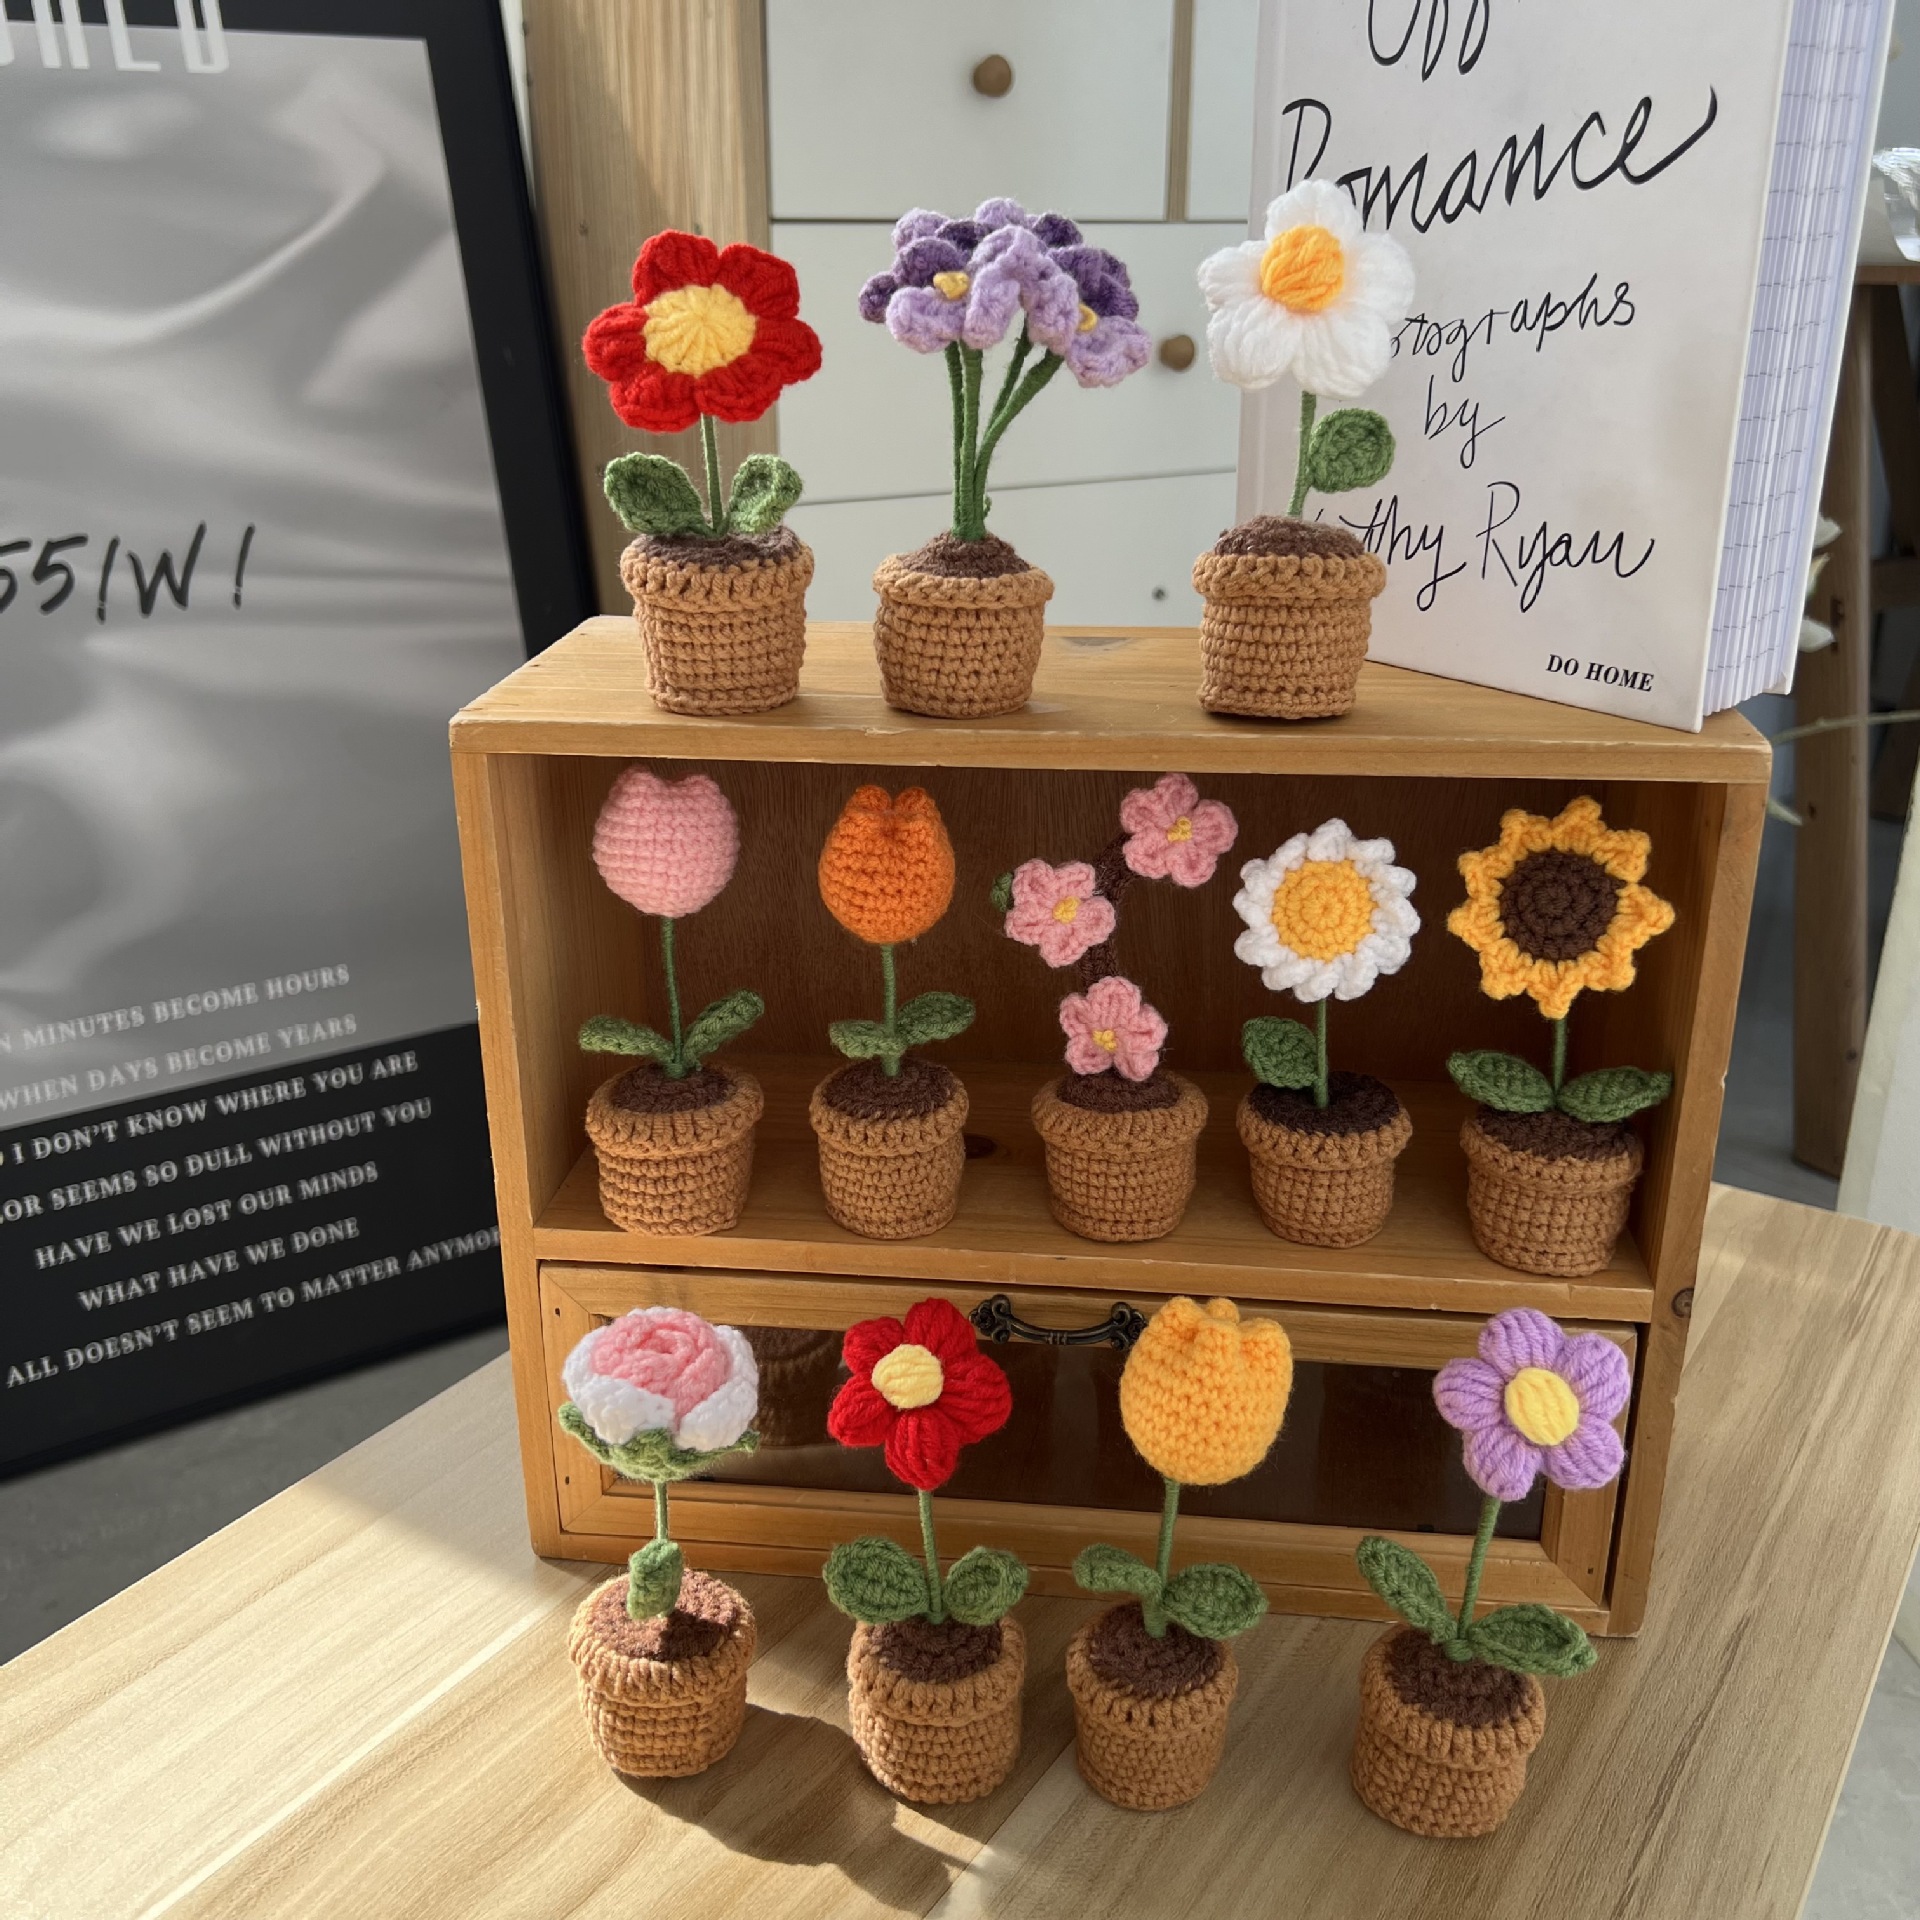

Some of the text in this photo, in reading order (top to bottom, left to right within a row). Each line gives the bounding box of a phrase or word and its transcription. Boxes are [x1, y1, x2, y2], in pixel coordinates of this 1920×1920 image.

[1424, 374, 1506, 469] by
[1315, 481, 1656, 613] thy Ryan
[1546, 653, 1656, 692] DO HOME
[22, 1005, 145, 1050] MINUTES
[151, 982, 259, 1024] BECOME
[264, 963, 350, 1000] HOURS
[0, 1013, 357, 1111] WHEN DAYS BECOME YEARS
[12, 1142, 25, 1165] I
[31, 1119, 119, 1159] DON'T
[125, 1098, 208, 1138] KNOW
[214, 1076, 307, 1116] WHERE
[310, 1062, 364, 1093] YOU
[369, 1050, 419, 1081] ARE
[0, 1096, 432, 1225] OR SEEMS SO DULL WITHOUT YOU
[33, 1160, 379, 1270] HAVE WE LOST OUR MINDS
[78, 1216, 361, 1312] WHAT HAVE WE DONE
[6, 1355, 60, 1389] ALL
[64, 1318, 180, 1371] DOESN'T
[184, 1297, 255, 1336] SEEM
[258, 1286, 295, 1313] TO
[300, 1256, 402, 1302] MATTER
